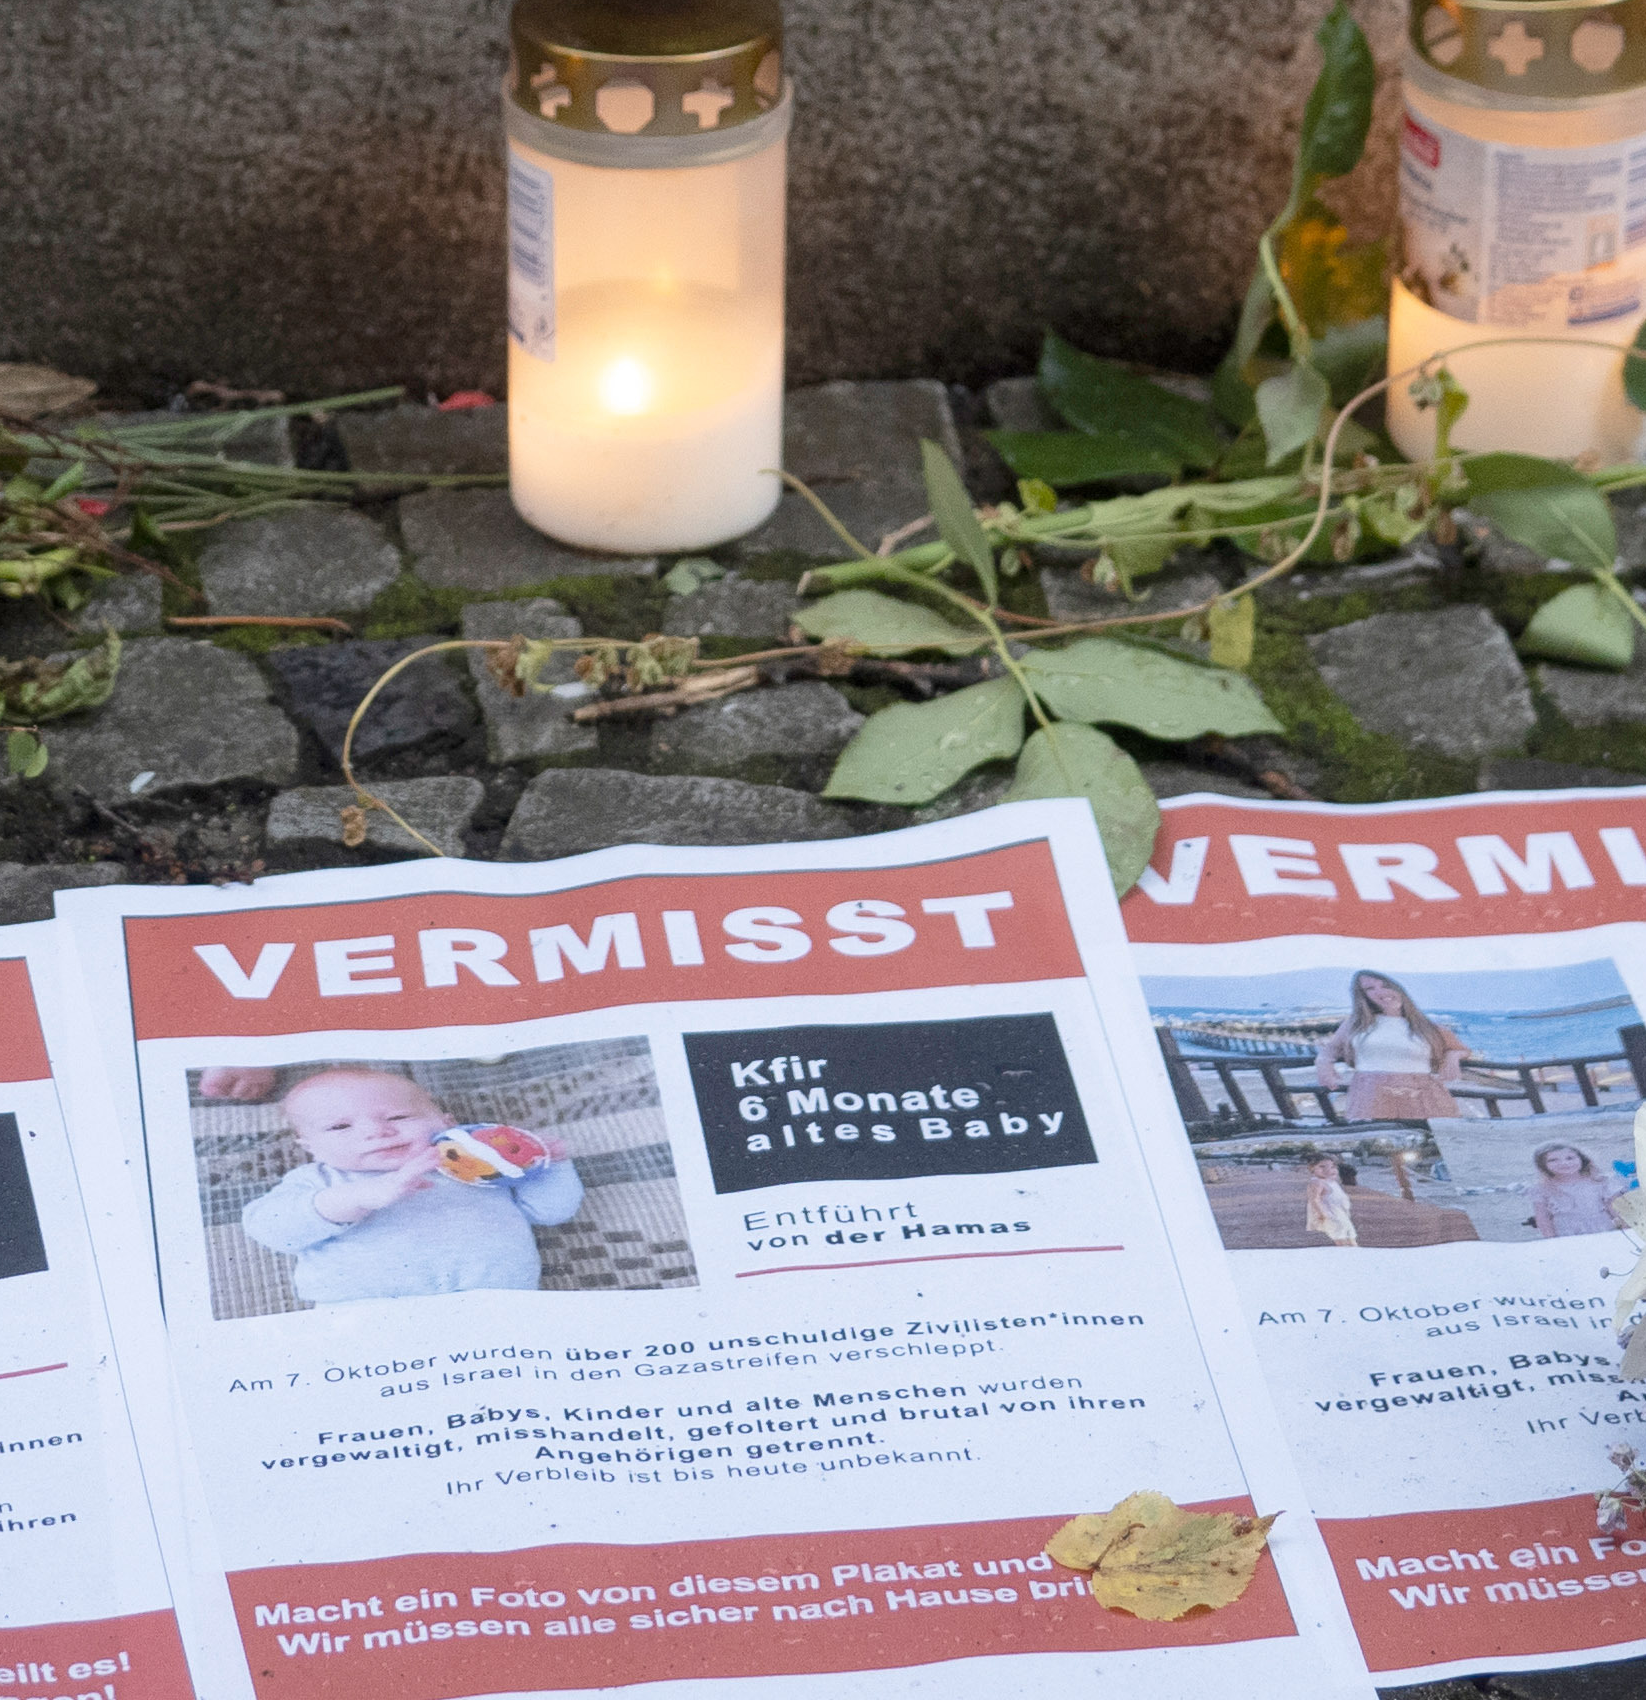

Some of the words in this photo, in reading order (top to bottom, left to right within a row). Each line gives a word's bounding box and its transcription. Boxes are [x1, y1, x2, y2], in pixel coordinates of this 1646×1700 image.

[194, 890, 1014, 1001] VERMISST
[729, 1054, 829, 1089] Kfir
[737, 1094, 769, 1123] 6
[785, 1083, 981, 1117] Monate
[745, 1120, 898, 1154] altes
[917, 1110, 1065, 1142] Baby
[742, 1200, 918, 1233] Entführt
[746, 1233, 810, 1253] von
[824, 1228, 886, 1247] der
[900, 1220, 1032, 1241] Hamas
[1257, 1310, 1308, 1327] Am
[1316, 1307, 1348, 1325] 7.
[1357, 1297, 1482, 1324] Oktober
[1492, 1295, 1607, 1311] wurden
[1425, 1319, 1482, 1339] aus
[1490, 1313, 1580, 1330] Israel
[228, 1378, 274, 1394] Am
[286, 1372, 312, 1389] 7.
[323, 1355, 438, 1384] Oktober
[448, 1344, 553, 1365] wurden
[564, 1347, 633, 1363] über
[643, 1340, 696, 1359] 200
[707, 1325, 895, 1352] unschuldige
[379, 1378, 431, 1399] aus
[441, 1364, 523, 1388] Israel
[533, 1368, 559, 1382] in
[569, 1367, 623, 1383] den
[633, 1350, 819, 1378] Gazastreifen
[828, 1338, 1005, 1363] verschleppt.
[1368, 1363, 1498, 1389] Frauen,
[317, 1423, 435, 1446] Frauen,
[445, 1404, 551, 1431] Babys,
[562, 1404, 665, 1423] Kinder
[676, 1398, 734, 1419] und
[745, 1395, 801, 1413] alte
[811, 1383, 968, 1409] Menschen
[977, 1375, 1083, 1396] wurden
[1314, 1377, 1536, 1414] vergewaltigt,
[260, 1438, 464, 1471] vergewaltigt,
[475, 1425, 675, 1447] misshandelt,
[686, 1415, 820, 1443] gefoltert
[830, 1407, 888, 1429] und
[898, 1400, 990, 1422] brutal
[998, 1399, 1057, 1415] von
[1067, 1394, 1147, 1411] ihren
[534, 1444, 734, 1466] Angehörigen
[745, 1430, 885, 1460] getrennt.
[445, 1478, 485, 1497] Ihr
[493, 1465, 617, 1487] Verbleib
[627, 1469, 663, 1485] ist
[672, 1467, 716, 1483] bis
[725, 1460, 809, 1479] heute
[819, 1446, 982, 1472] unbekannt.
[1354, 1547, 1501, 1582] Macht
[1507, 1541, 1580, 1571] ein
[253, 1595, 385, 1628] Macht
[393, 1587, 459, 1614] ein
[469, 1586, 567, 1609] Foto
[575, 1585, 657, 1607] von
[668, 1572, 821, 1599] diesem
[830, 1559, 964, 1588] Plakat
[972, 1551, 1054, 1576] und
[1387, 1581, 1472, 1611] Wir
[275, 1630, 352, 1658] Wir
[362, 1618, 532, 1651] müssen
[543, 1614, 617, 1637] alle
[628, 1603, 760, 1631] sicher
[771, 1593, 875, 1622] nach
[884, 1586, 1019, 1612] Hause
[66, 1650, 132, 1681] es!
